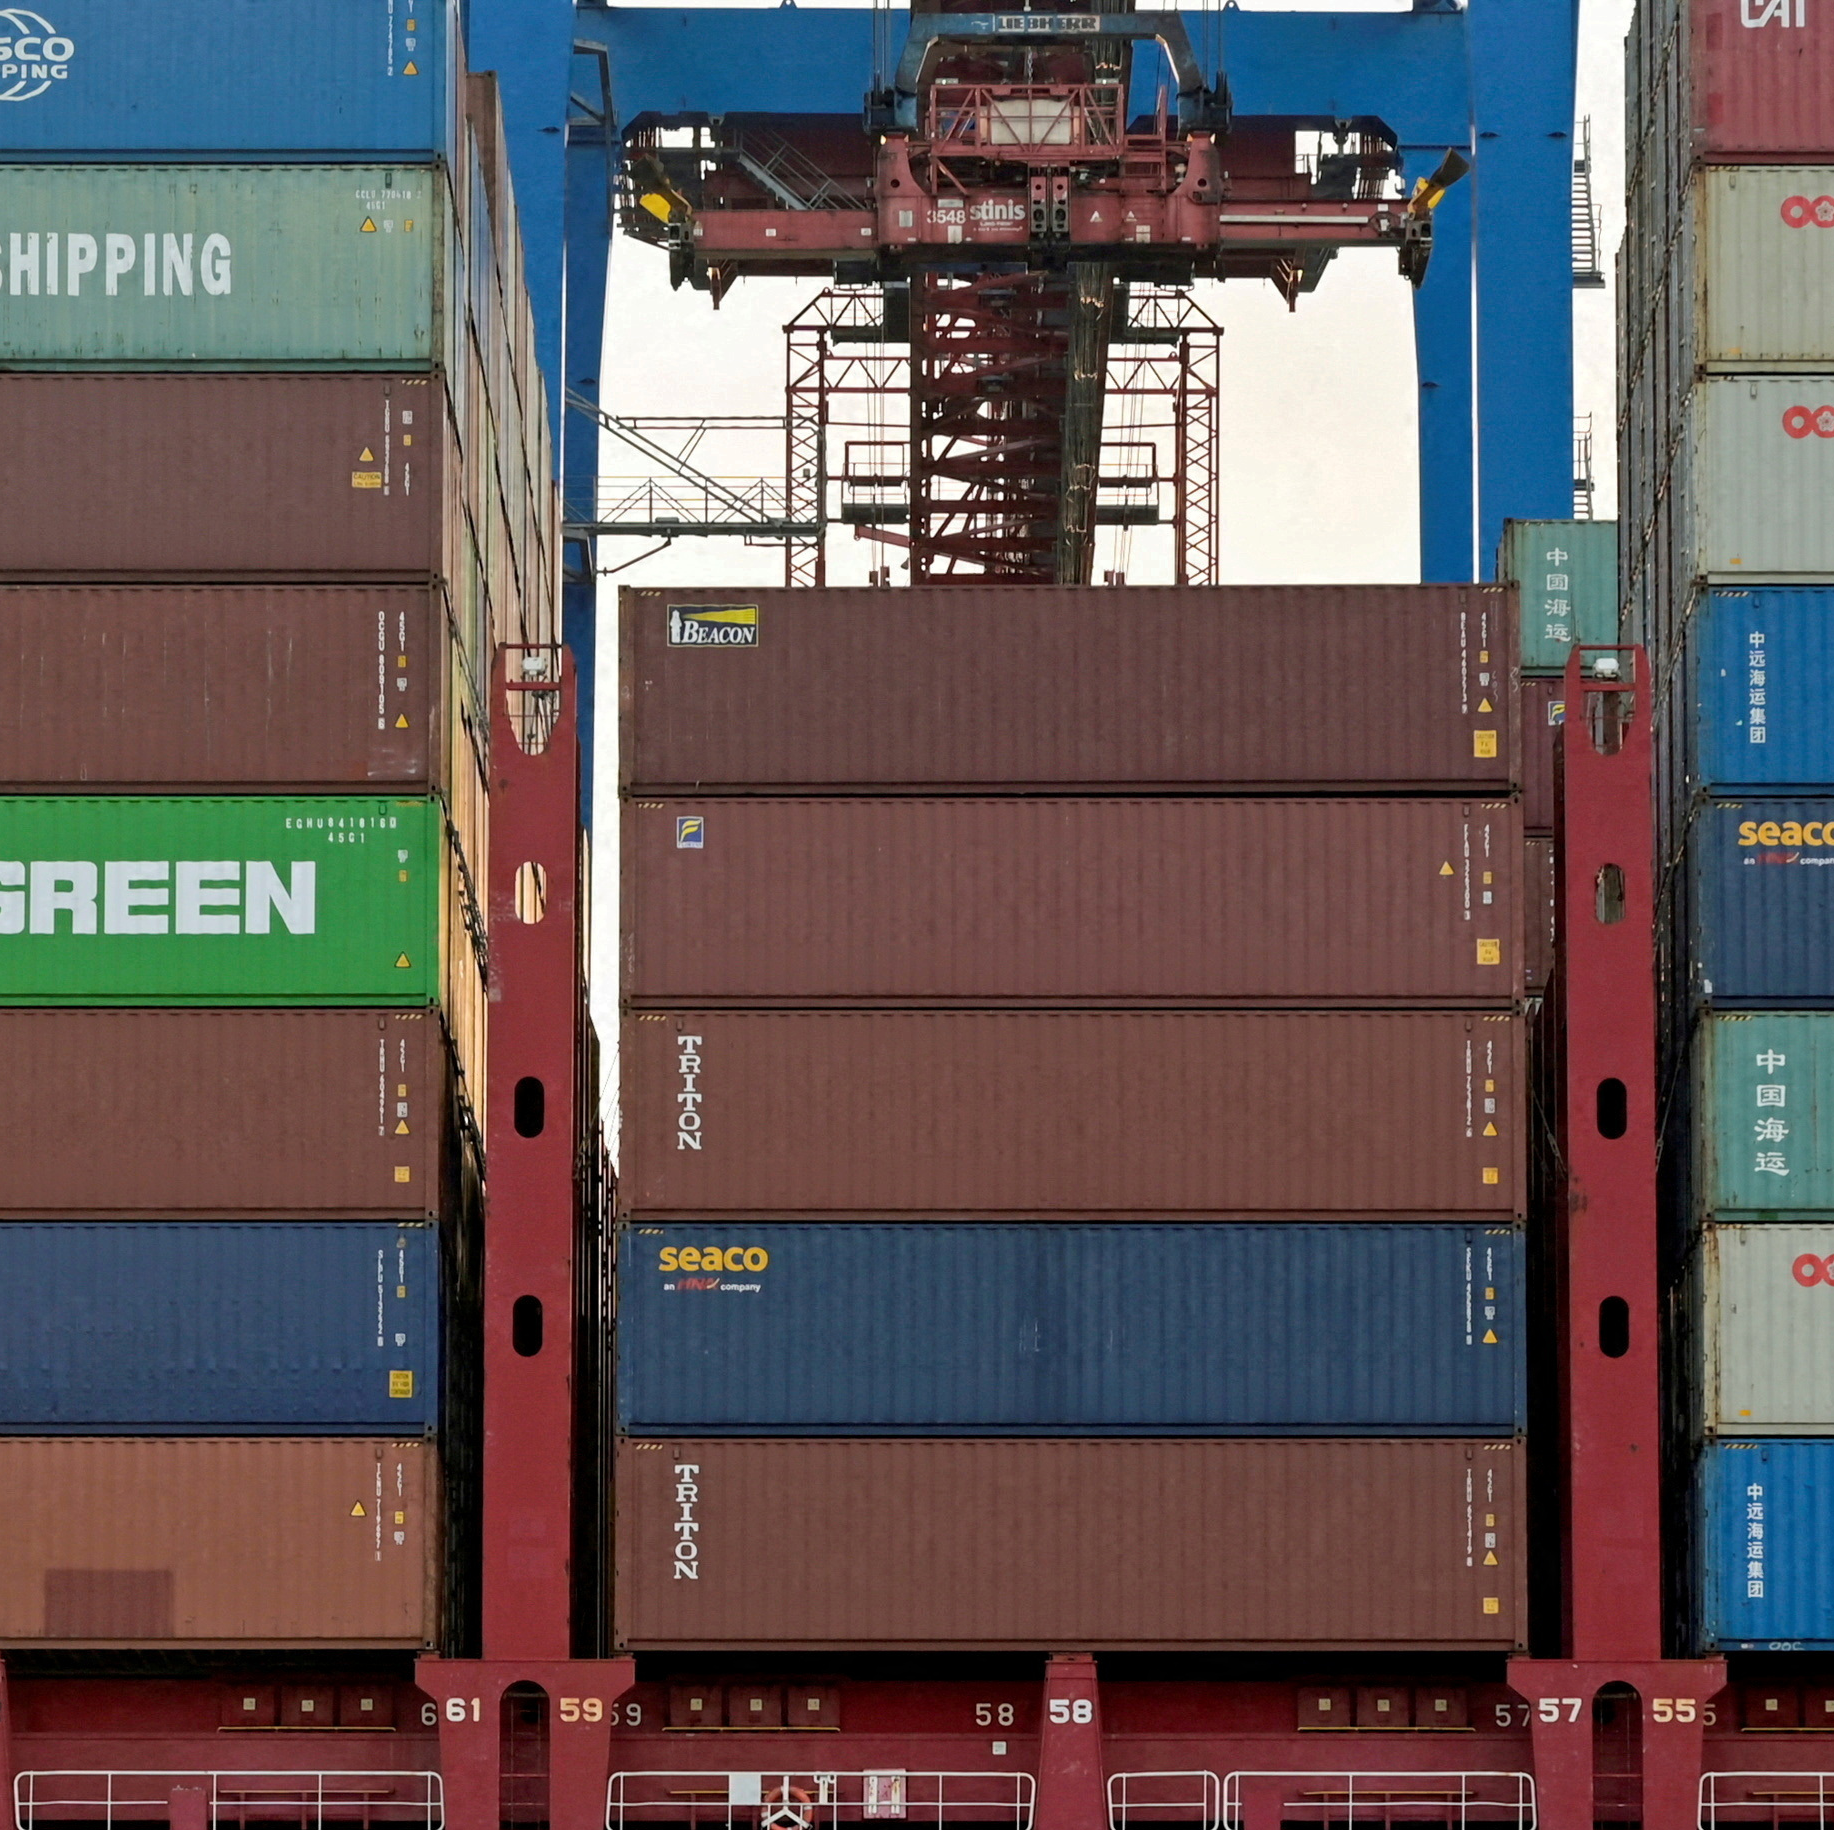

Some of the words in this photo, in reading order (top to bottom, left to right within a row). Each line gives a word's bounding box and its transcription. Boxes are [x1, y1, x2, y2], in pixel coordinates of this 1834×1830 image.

[998, 16, 1098, 31] LIEBHERR
[927, 210, 965, 223] 3548
[970, 199, 1026, 220] stinis
[1545, 548, 1570, 641] 中国海运
[681, 620, 755, 644] BEACON
[1750, 631, 1765, 743] 中远海运集团
[328, 832, 365, 844] 45G1
[678, 1036, 702, 1149] TRITON
[1754, 1049, 1789, 1176] 中国海运
[659, 1246, 768, 1272] seaco
[721, 1284, 760, 1292] company
[674, 1465, 699, 1579] TRITON
[1747, 1483, 1763, 1597] 中远海运集团
[446, 1698, 479, 1721] 61
[561, 1698, 602, 1721] 59
[976, 1704, 1013, 1726] 58
[1050, 1699, 1092, 1723] 58
[1539, 1698, 1581, 1722] 57
[1653, 1699, 1695, 1722] 55
